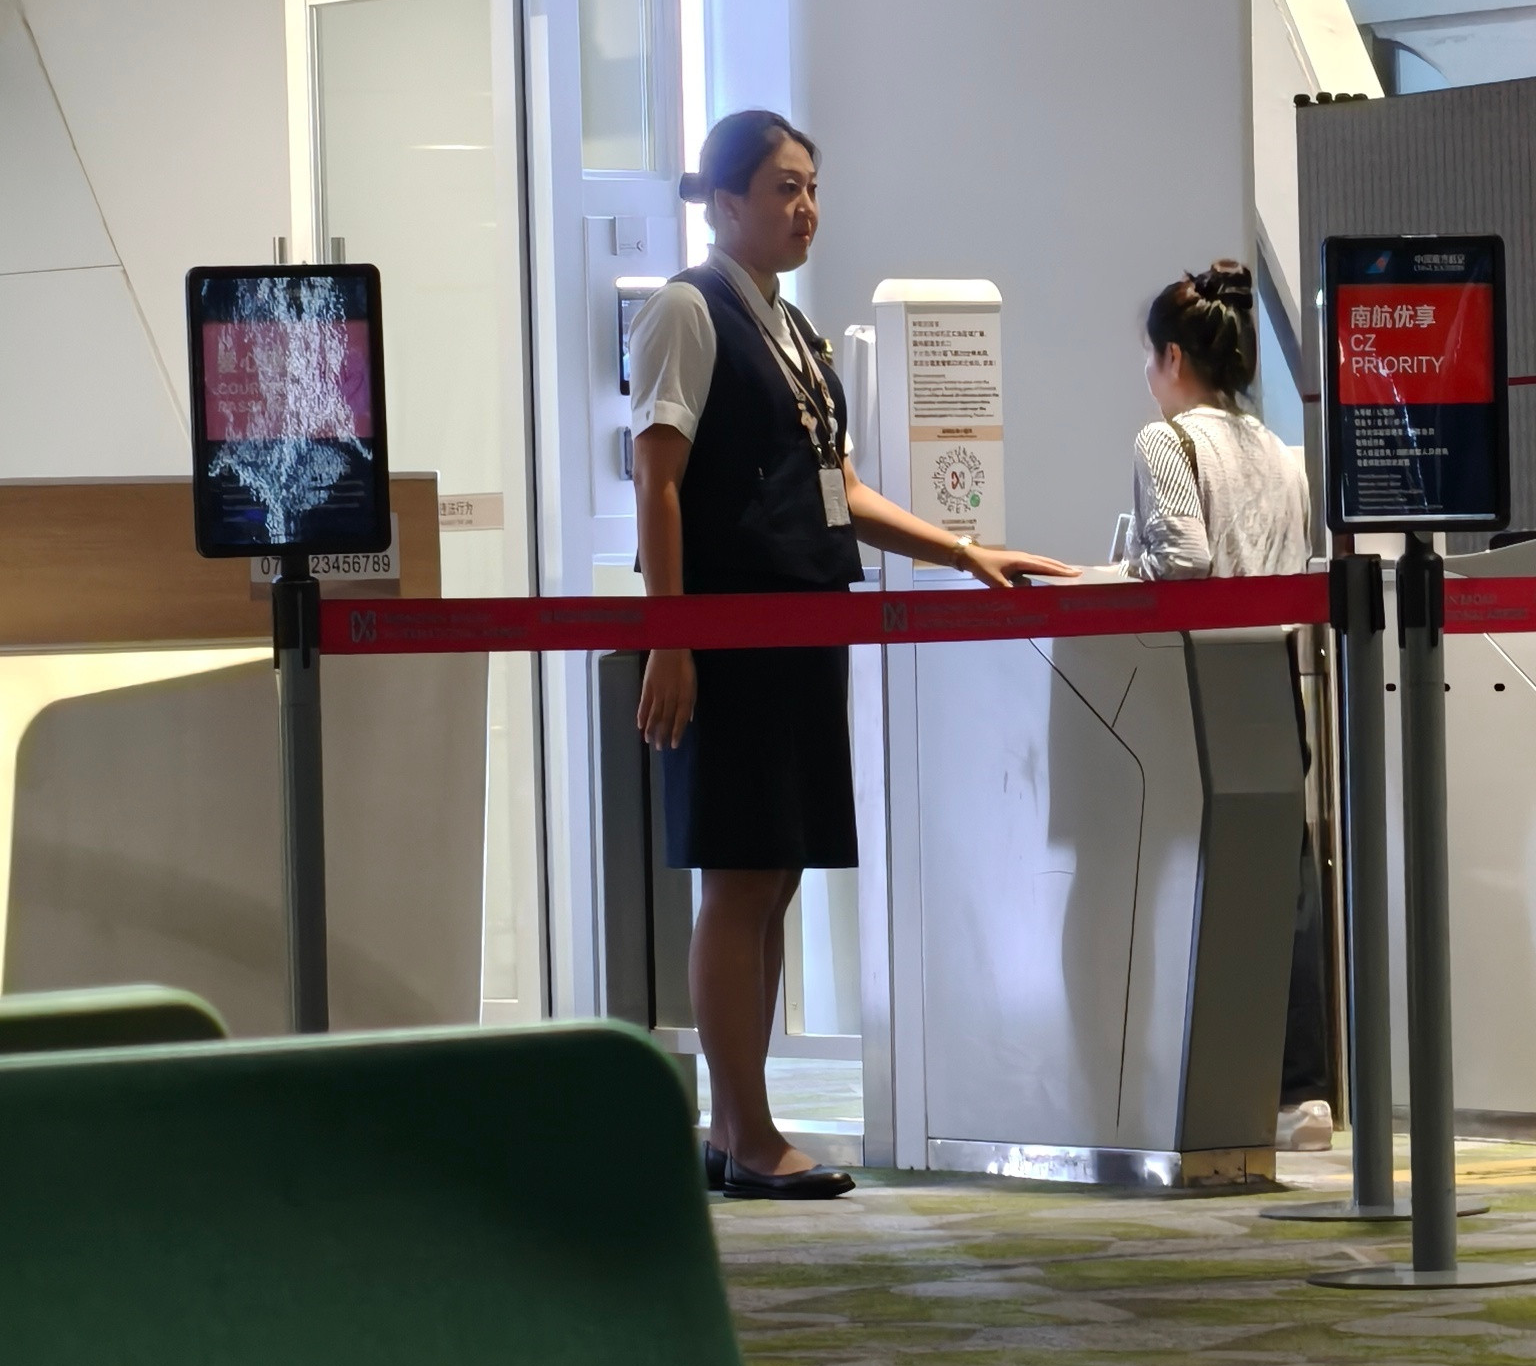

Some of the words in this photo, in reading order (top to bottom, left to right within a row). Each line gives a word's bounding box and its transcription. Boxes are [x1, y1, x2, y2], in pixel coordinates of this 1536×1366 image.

[1351, 305, 1436, 328] 南航优享
[1351, 334, 1377, 352] CZ
[1352, 355, 1445, 375] PRIORITY
